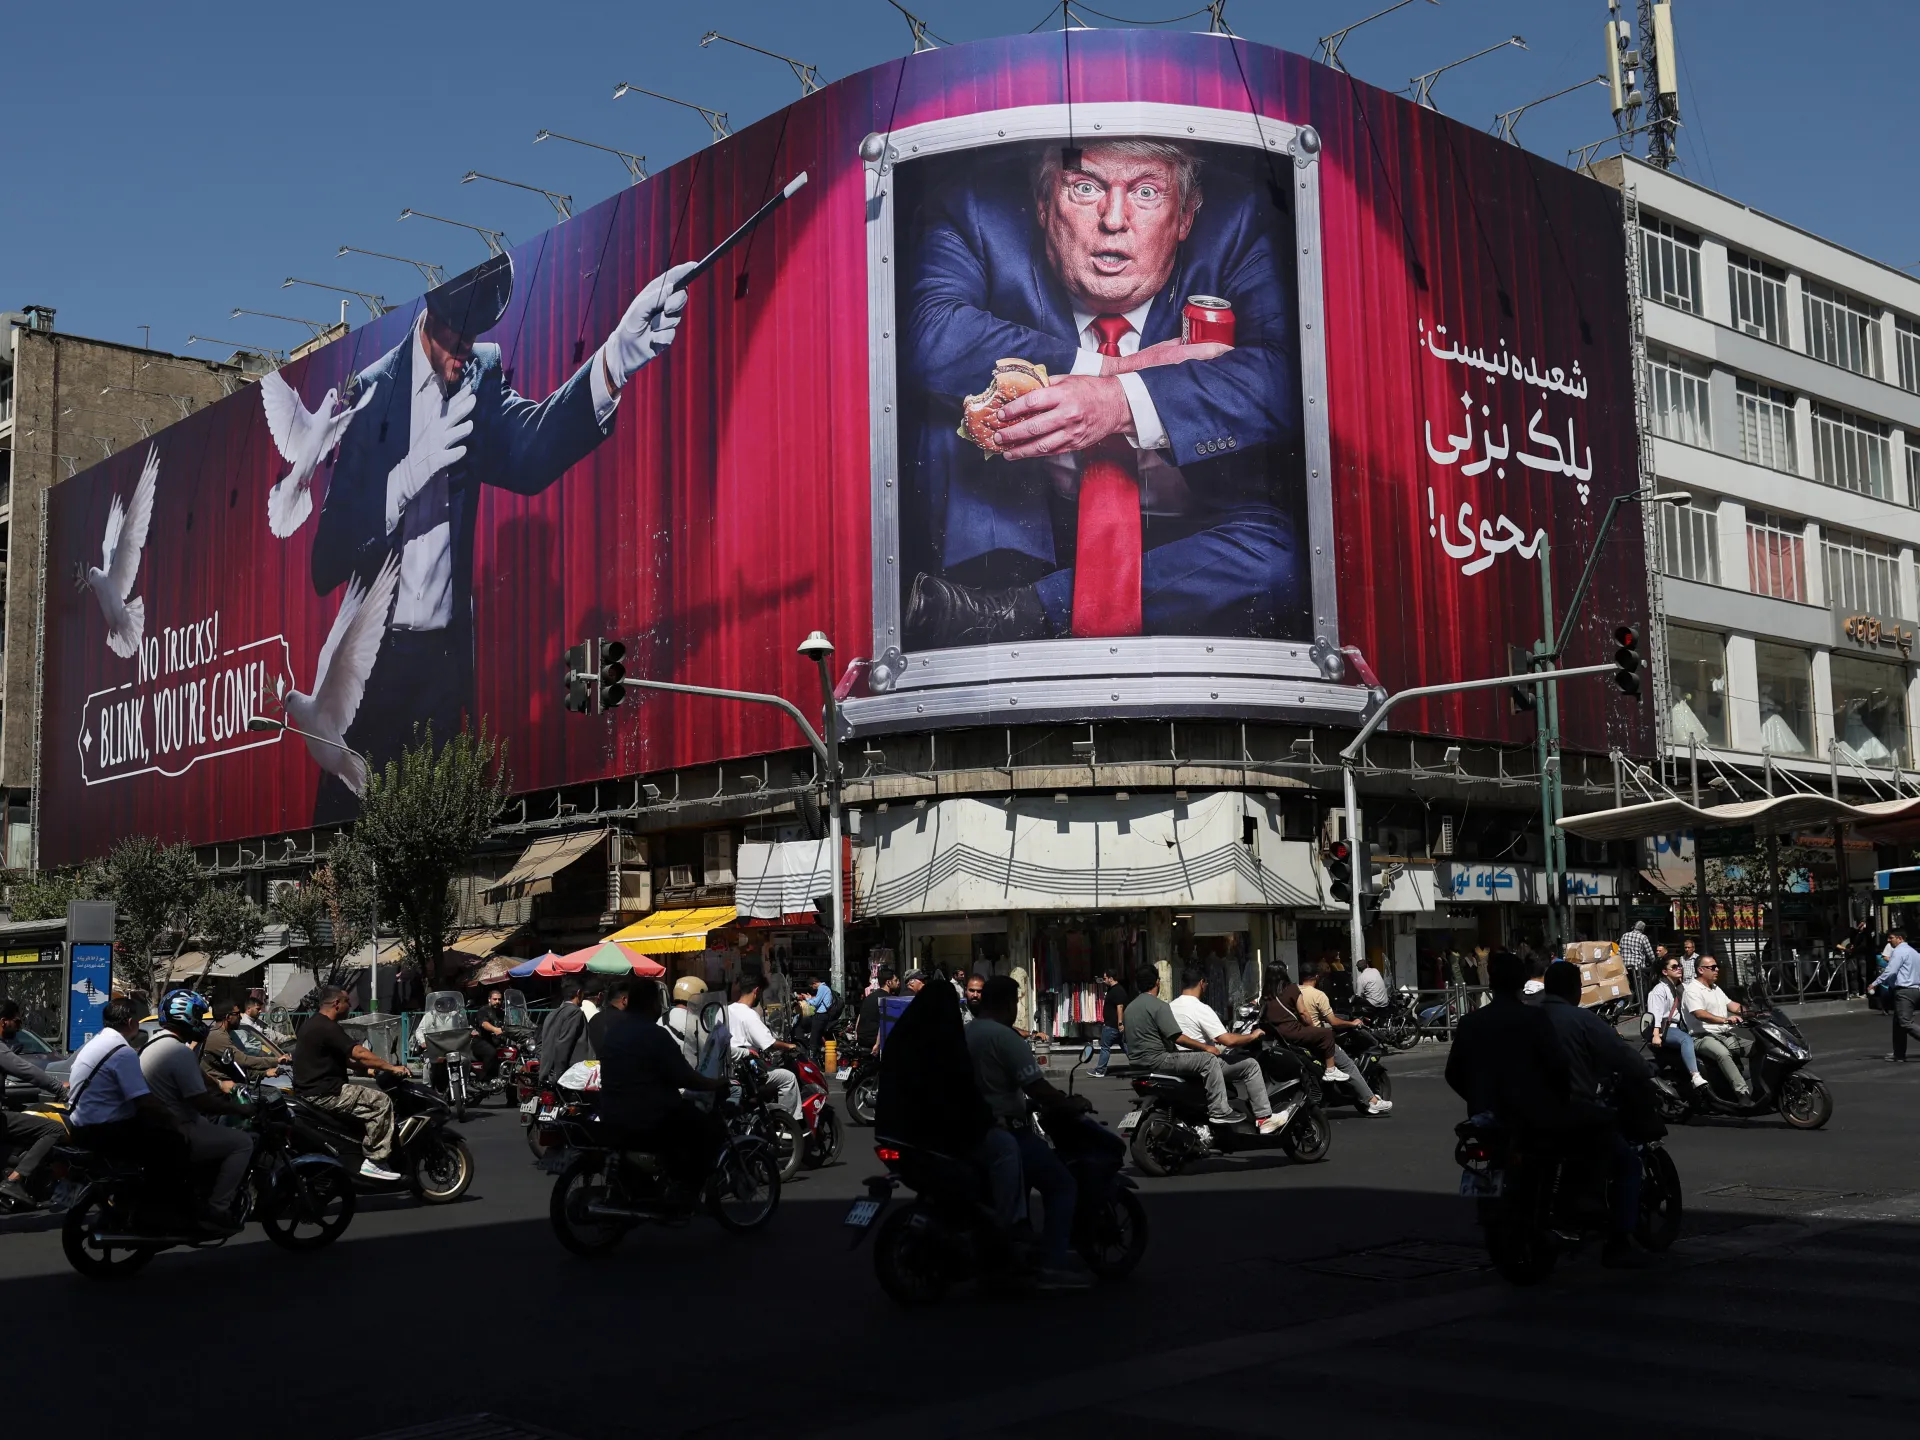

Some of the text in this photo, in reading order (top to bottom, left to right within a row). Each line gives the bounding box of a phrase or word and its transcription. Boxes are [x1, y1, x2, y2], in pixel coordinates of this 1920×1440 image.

[1418, 318, 1588, 400] شعبده نیست!
[1425, 391, 1593, 505] پلک بزنی
[138, 610, 218, 685] NO TRICKS!
[100, 660, 265, 768] BLINK, YOU'RE GONE!
[1476, 868, 1513, 896] کوه
